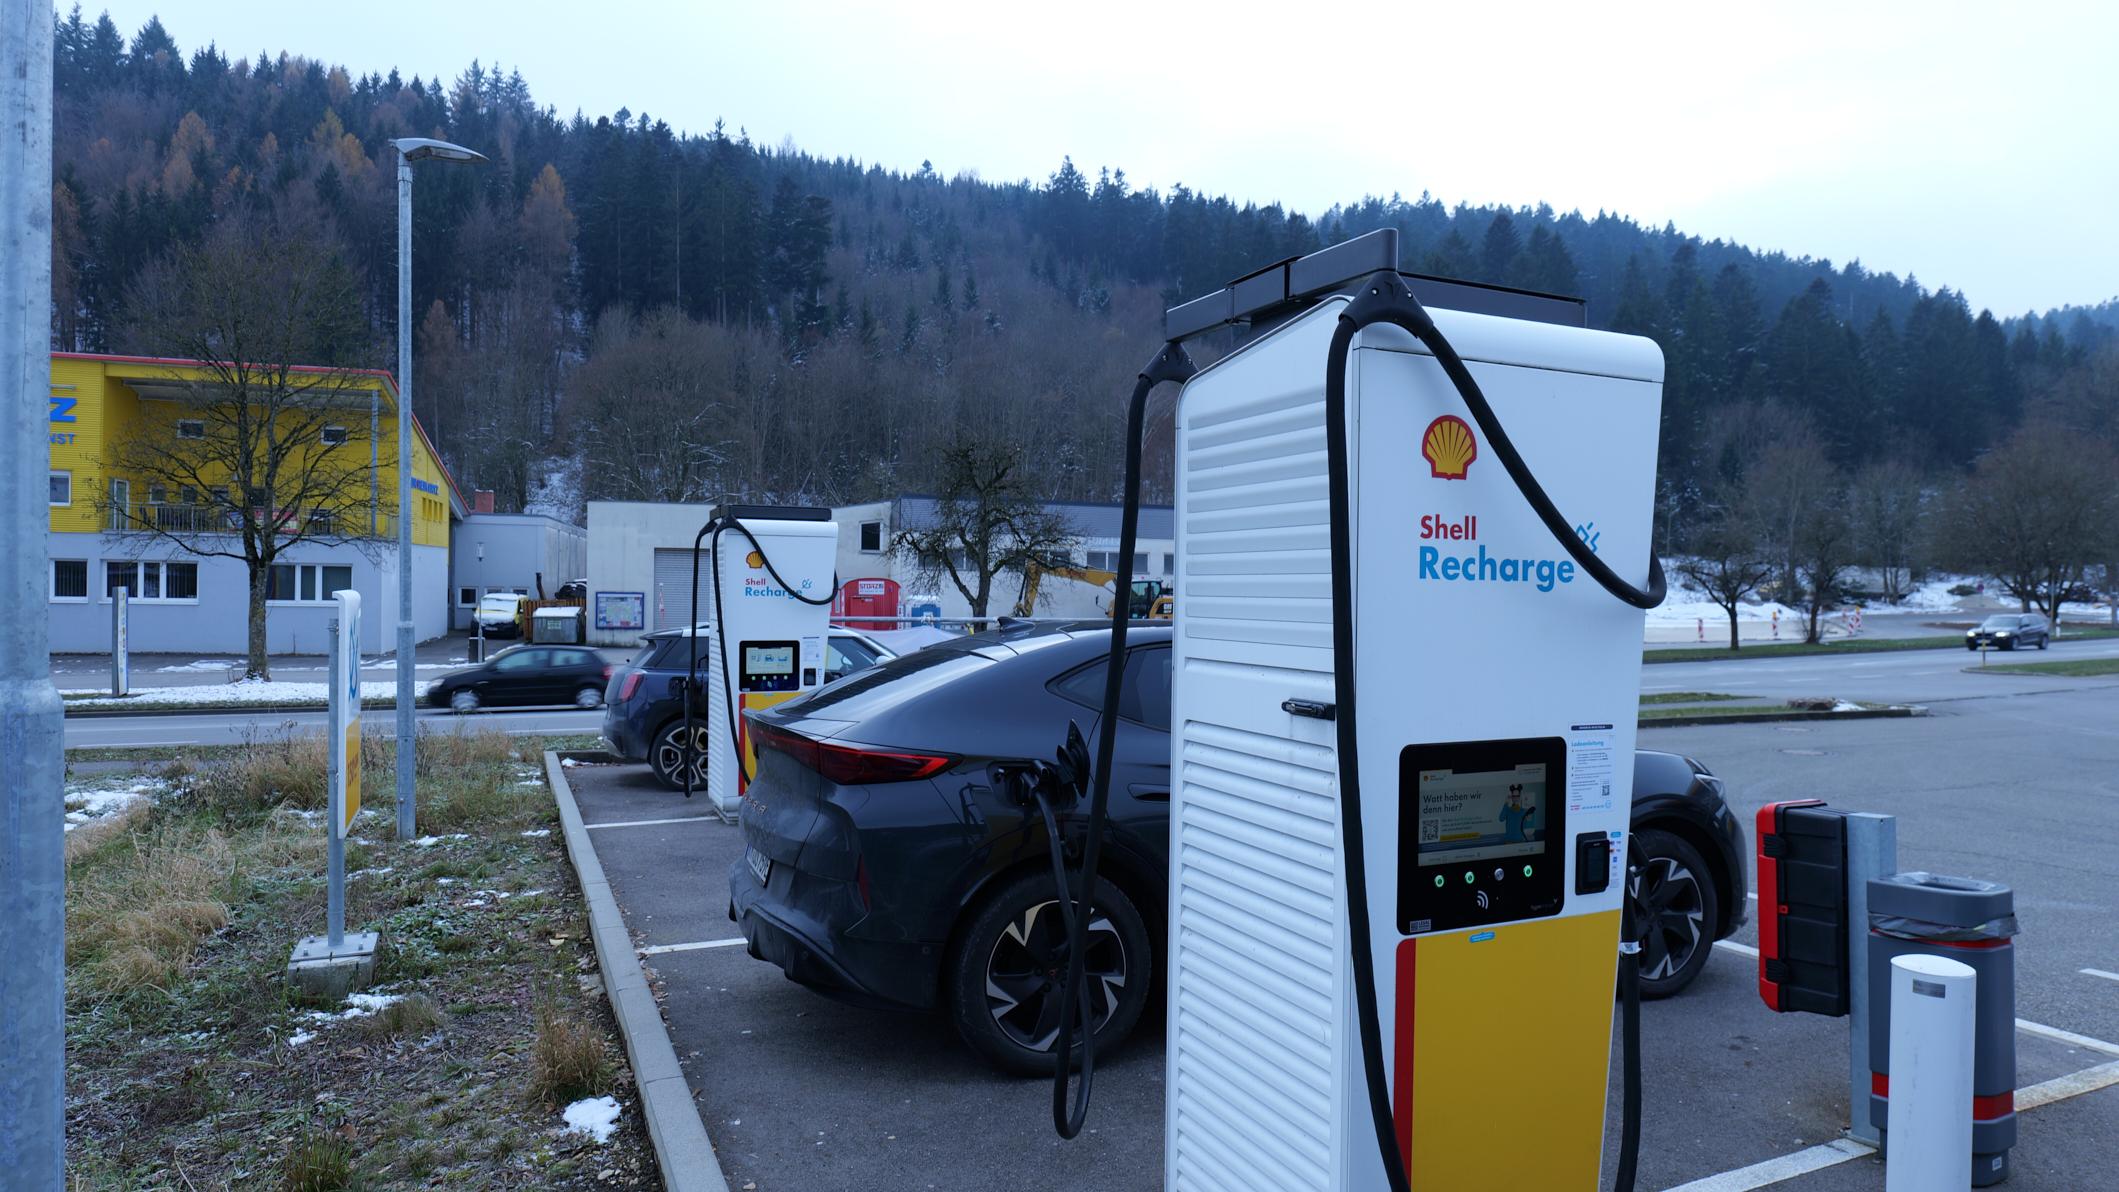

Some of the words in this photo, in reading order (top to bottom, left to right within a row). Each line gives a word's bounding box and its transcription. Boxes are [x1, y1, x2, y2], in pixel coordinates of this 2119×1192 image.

[1420, 514, 1477, 540] Shell
[1419, 545, 1575, 593] Recharge
[745, 578, 766, 586] Shell
[1423, 793, 1443, 803] Watt
[1444, 791, 1468, 802] haben
[1469, 791, 1482, 800] wir
[1423, 804, 1442, 815] denn
[1444, 803, 1463, 813] hier?
